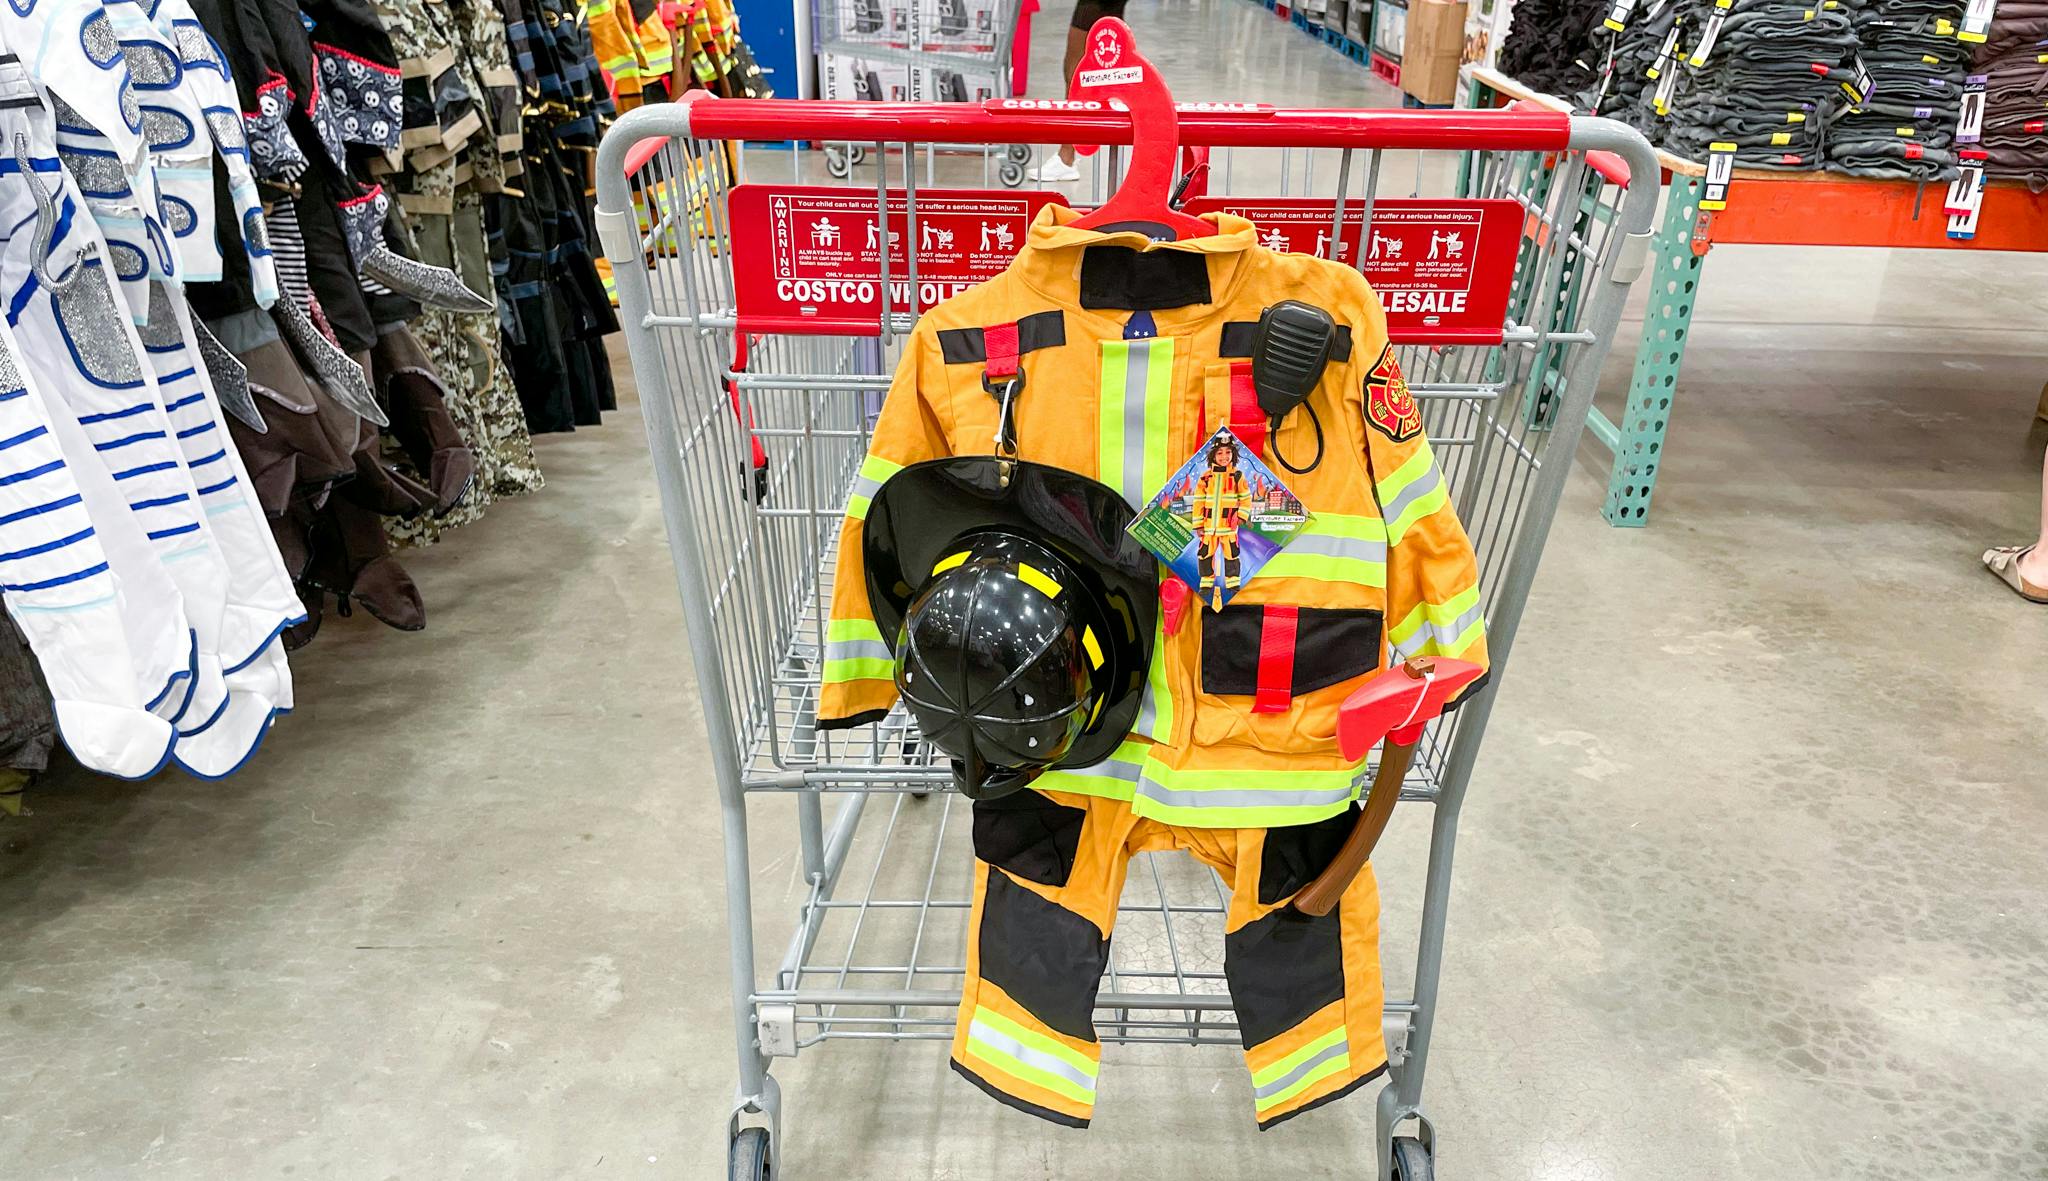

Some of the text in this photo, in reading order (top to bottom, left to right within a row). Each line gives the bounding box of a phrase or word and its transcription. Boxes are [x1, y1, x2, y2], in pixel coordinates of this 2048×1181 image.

[1098, 40, 1116, 55] 3-4
[827, 66, 836, 100] ATIER
[1002, 100, 1102, 109] COSTCO
[774, 209, 791, 276] WARNING
[777, 280, 874, 304] COSTCO
[1378, 292, 1468, 312] LESALE
[1166, 516, 1192, 542] WARNING
[1154, 531, 1180, 556] WARNING
